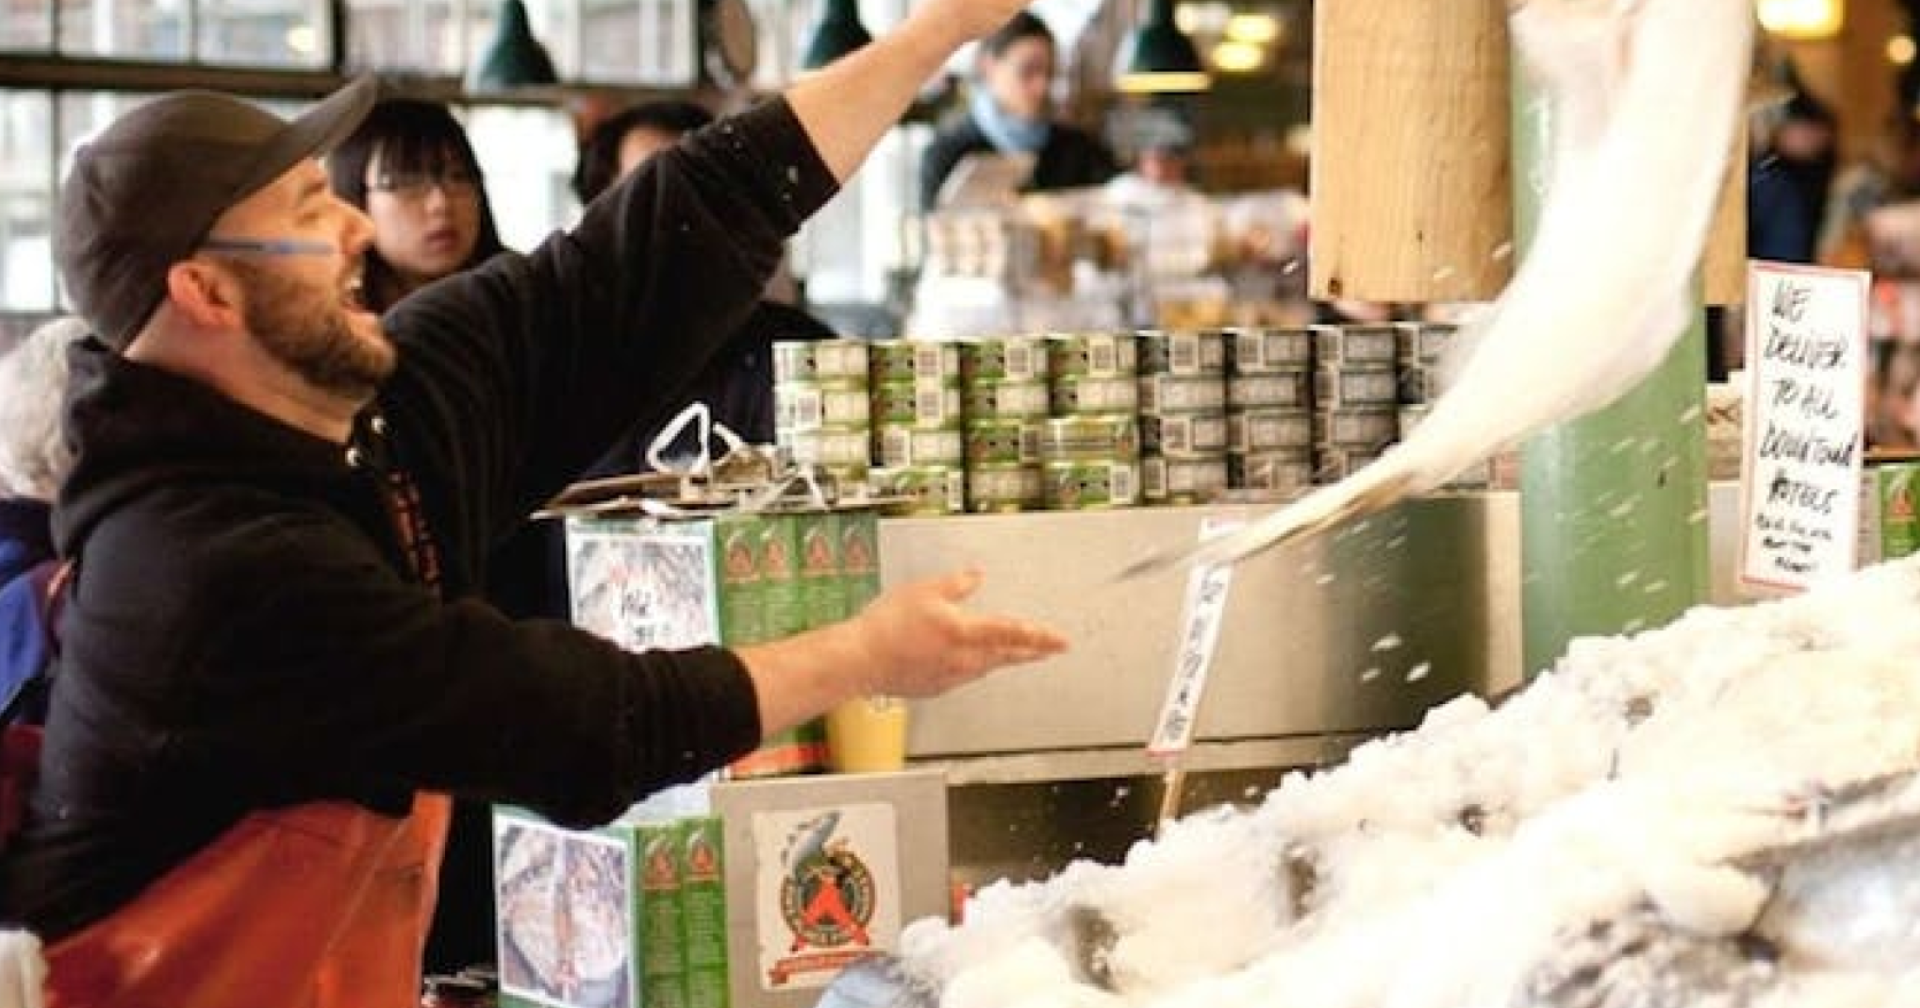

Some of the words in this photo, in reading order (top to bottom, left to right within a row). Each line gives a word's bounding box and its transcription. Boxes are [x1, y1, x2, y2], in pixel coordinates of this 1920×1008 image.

[1772, 279, 1811, 322] WE
[1764, 326, 1848, 369] DELIVER
[1769, 379, 1799, 406] TO
[1802, 385, 1838, 420] ALL
